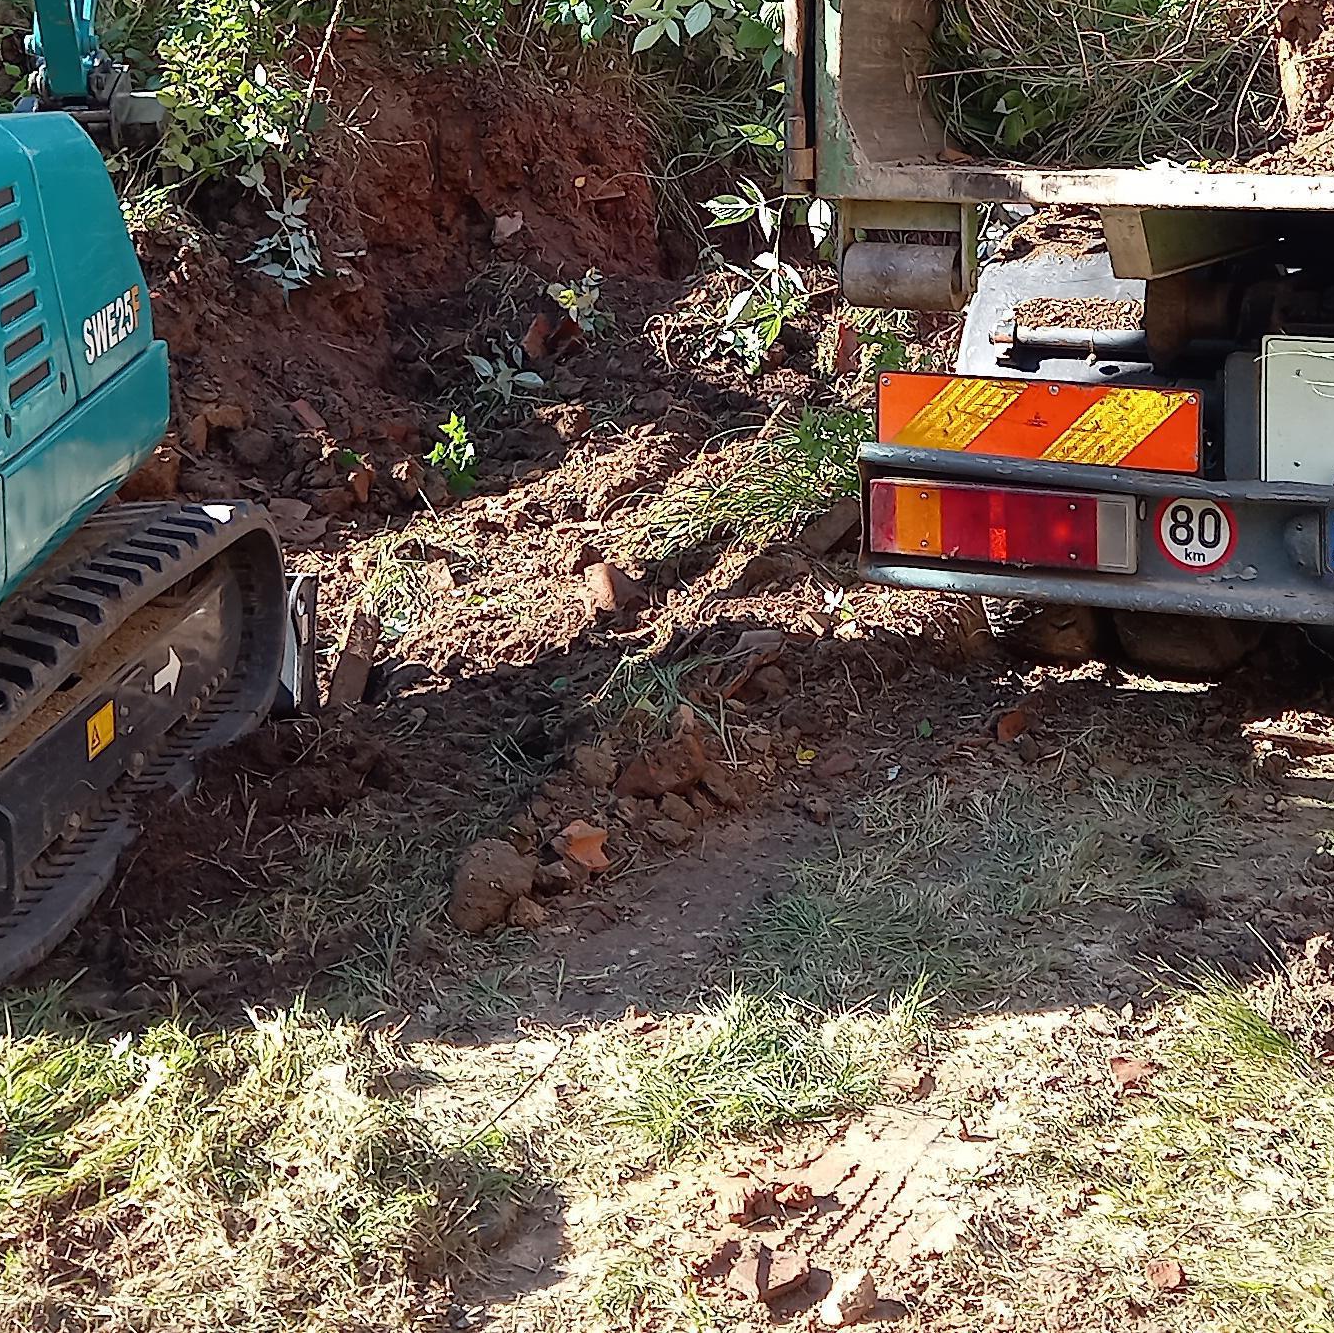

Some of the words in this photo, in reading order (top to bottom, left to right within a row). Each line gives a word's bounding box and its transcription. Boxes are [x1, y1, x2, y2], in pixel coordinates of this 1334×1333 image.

[83, 283, 140, 365] SWE25F
[1169, 505, 1221, 549] 80
[1184, 548, 1206, 563] km
